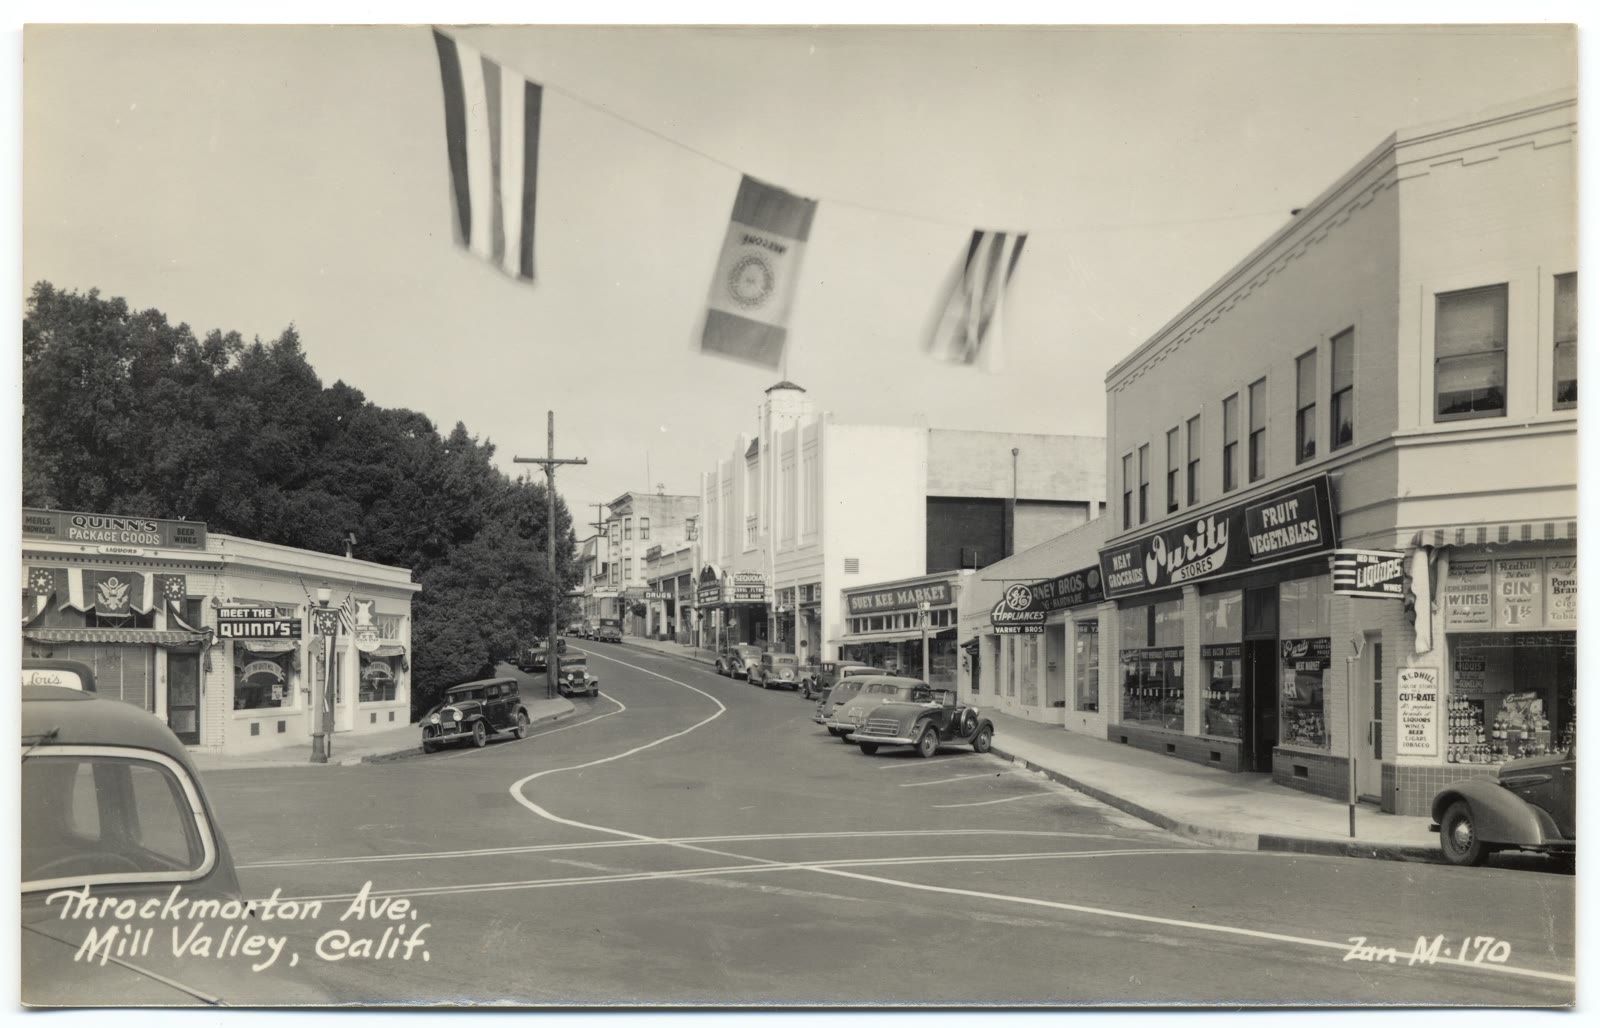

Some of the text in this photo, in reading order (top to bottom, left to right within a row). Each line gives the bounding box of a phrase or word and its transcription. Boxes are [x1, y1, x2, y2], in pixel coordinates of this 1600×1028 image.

[1262, 498, 1298, 528] FRUIT
[71, 515, 159, 533] QUINN'S
[69, 527, 160, 545] PACKAGE GOODS
[176, 527, 195, 537] BEER
[1249, 519, 1319, 555] VEGETABLES
[173, 535, 198, 545] WINES
[1145, 514, 1230, 585] Purity
[1112, 553, 1131, 571] MEAT
[1180, 556, 1213, 579] STORES
[1500, 560, 1536, 571] Redhill
[735, 574, 764, 582] SEQUOIA
[1108, 569, 1143, 588] GROCERIES
[1356, 558, 1403, 588] LIQUORS
[1383, 583, 1403, 593] WINES
[1503, 582, 1533, 596] GIN
[1551, 577, 1577, 588] Popu
[645, 591, 672, 599] DRUGS
[851, 585, 945, 610] SUEY KEE MARKET
[1033, 581, 1056, 600] RNEY
[1448, 594, 1489, 605] WINES
[1555, 600, 1577, 609] Ciga
[220, 608, 273, 618] MEET THE
[991, 600, 1045, 621] APPLIANCES
[220, 621, 291, 638] QUINN'S
[995, 626, 1022, 634] VARNEY
[1401, 671, 1435, 684] REDHILL
[1399, 693, 1436, 702] CUT-RATE
